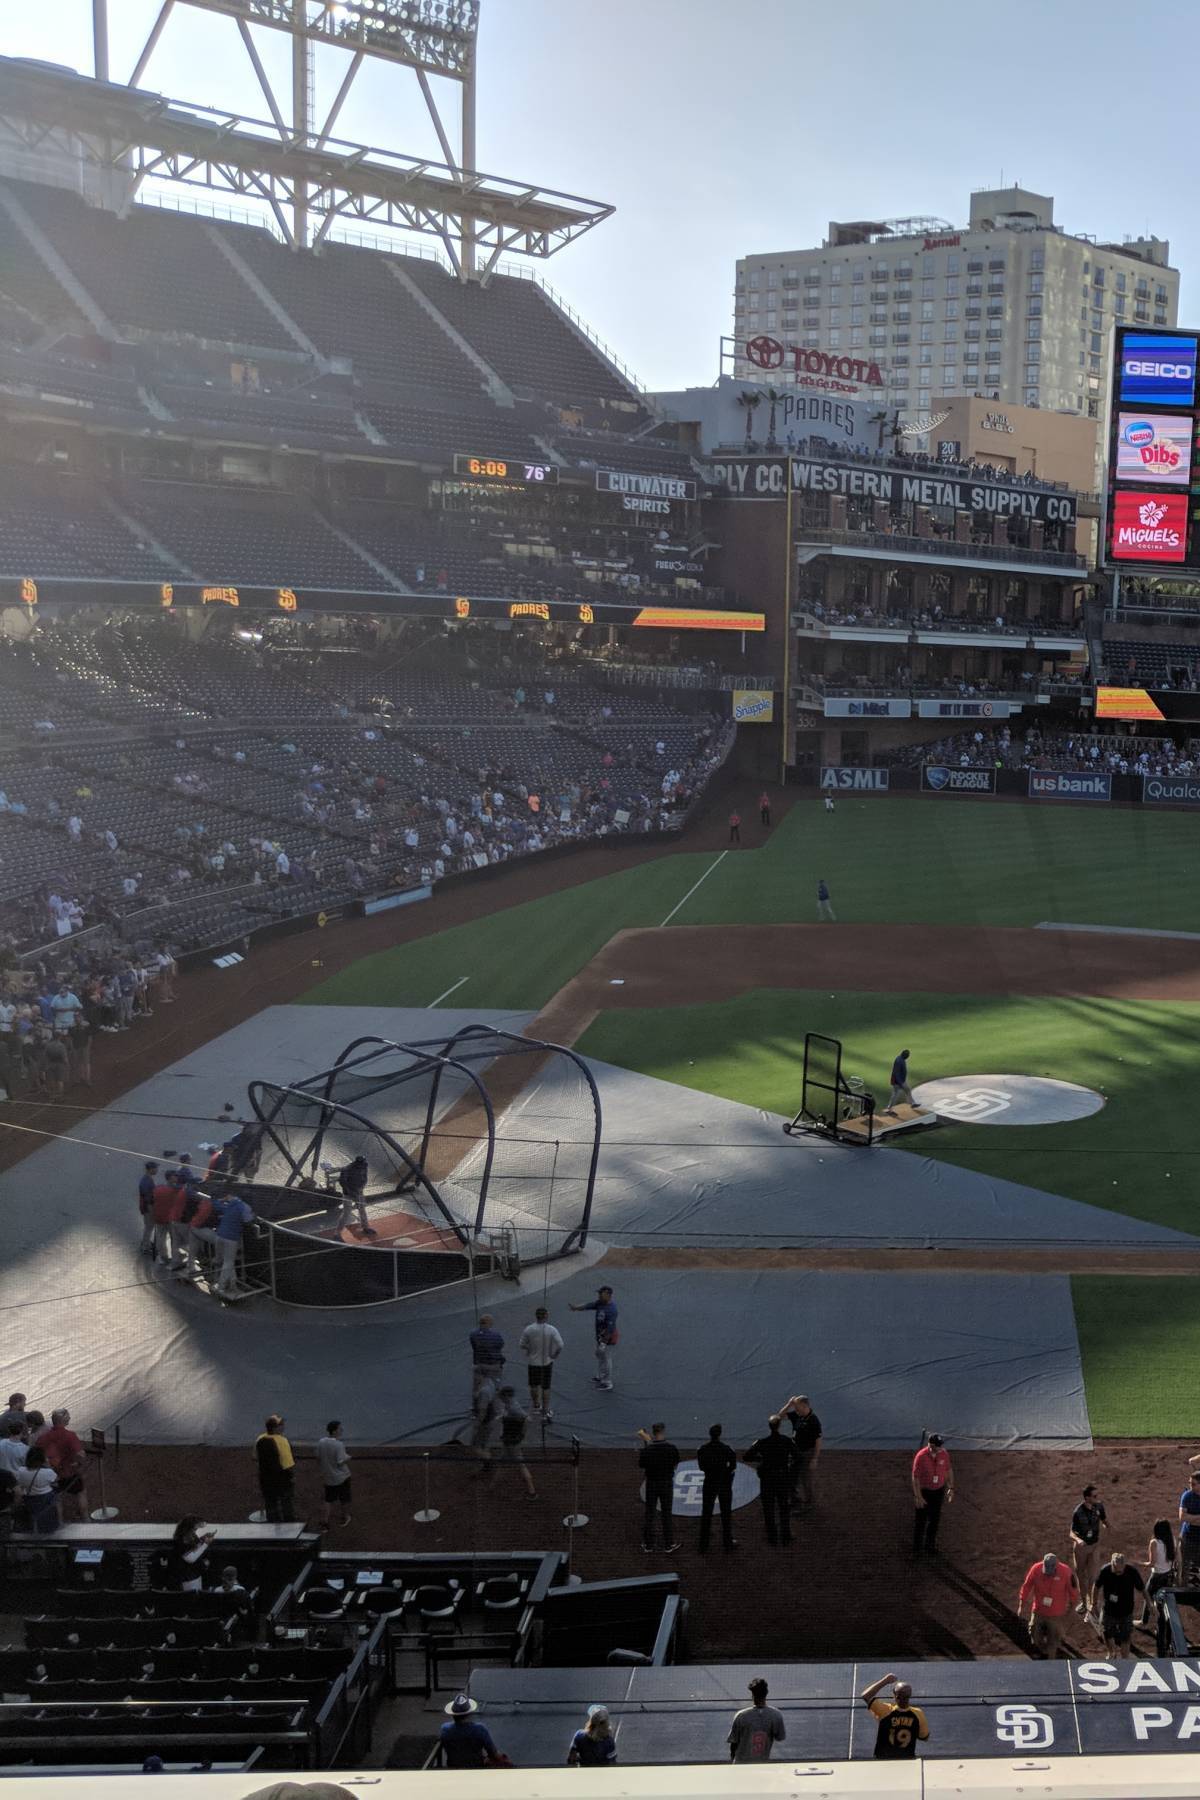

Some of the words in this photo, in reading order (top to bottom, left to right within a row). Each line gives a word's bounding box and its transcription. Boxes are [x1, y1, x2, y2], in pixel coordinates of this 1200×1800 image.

[790, 345, 883, 386] TOYOTA
[1125, 360, 1192, 379] GEICO
[784, 395, 855, 436] PADRES
[1140, 443, 1180, 466] Dibs
[468, 458, 507, 477] 6:09
[524, 464, 551, 481] 76°
[608, 472, 687, 498] CUTWATER
[792, 462, 893, 498] WESTERN
[902, 477, 966, 509] METAL
[971, 486, 1041, 522] SUPPLY
[1046, 497, 1076, 523] CO.
[623, 497, 671, 514] SPIRITS
[202, 586, 239, 607] PADRES
[510, 602, 550, 620] PADRES
[735, 697, 773, 719] Snapple
[822, 768, 888, 788] ASML
[950, 779, 990, 790] LEAGUE
[951, 770, 990, 781] ROCKET
[888, 1728, 912, 1749] 19
